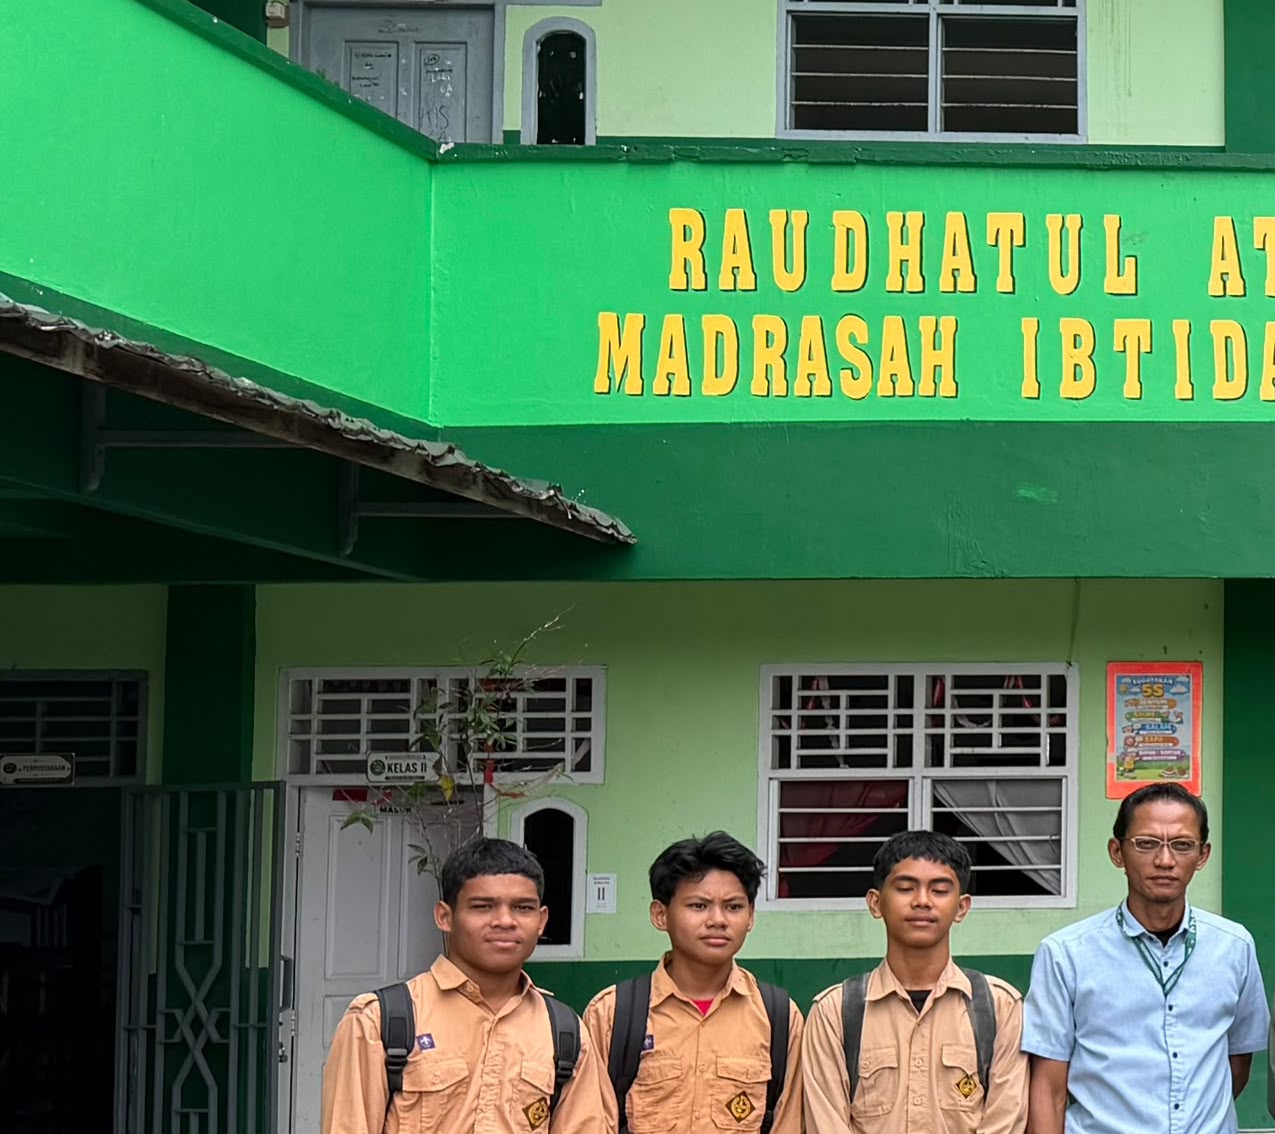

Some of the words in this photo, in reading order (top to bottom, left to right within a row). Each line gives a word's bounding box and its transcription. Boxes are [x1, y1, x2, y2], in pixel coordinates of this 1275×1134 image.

[670, 208, 1137, 294] RAUDHATUL
[594, 312, 958, 400] MADRASAH
[1142, 683, 1165, 698] 5S
[386, 762, 418, 774] KELAS
[420, 762, 427, 773] II
